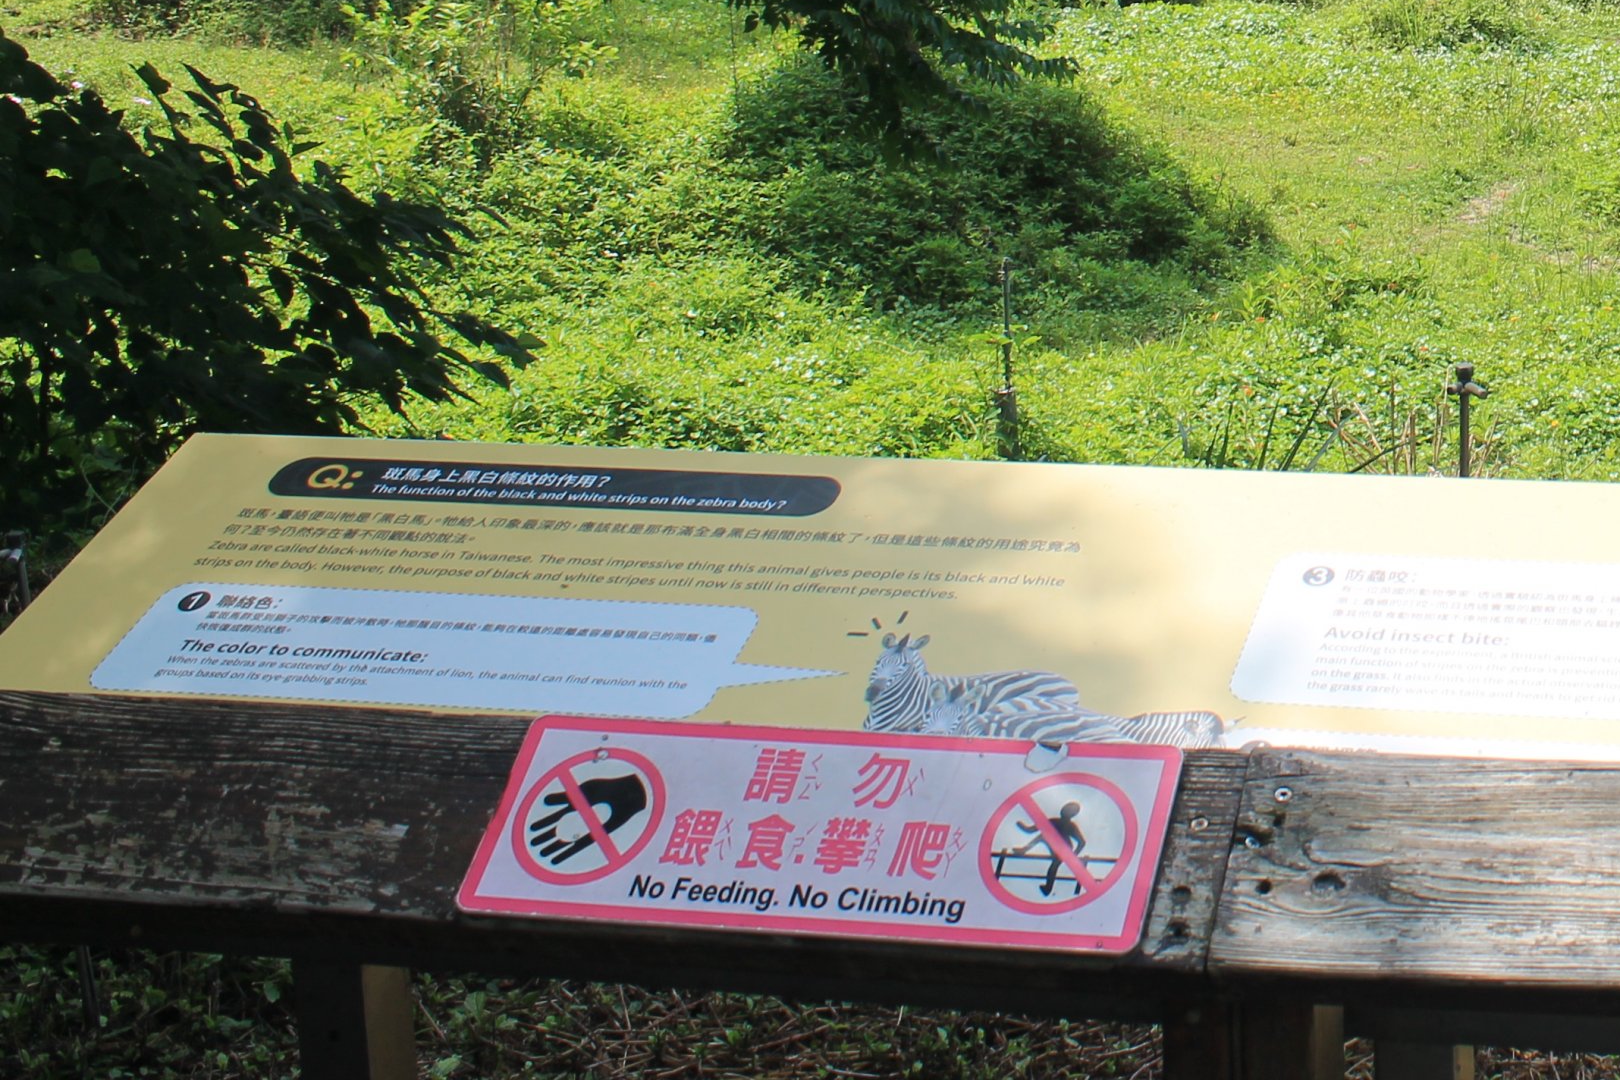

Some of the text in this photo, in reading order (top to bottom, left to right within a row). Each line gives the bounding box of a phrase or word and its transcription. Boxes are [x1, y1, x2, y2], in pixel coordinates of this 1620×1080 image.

[307, 464, 363, 490] Q:
[368, 482, 788, 512] The function of the black and white strips on the zebra body?
[207, 538, 247, 551] Zebra
[249, 542, 272, 552] are
[274, 541, 316, 554] called
[317, 542, 398, 557] black-white
[398, 545, 438, 559] horse
[441, 547, 454, 559] in
[456, 548, 536, 563] Taiwanese.
[536, 551, 565, 564] The
[567, 555, 606, 566] most
[605, 554, 683, 570] impressive
[686, 558, 726, 574] thing
[726, 560, 755, 572] this
[758, 562, 811, 575] animal
[810, 564, 850, 578] gives
[852, 567, 904, 582] people
[906, 568, 921, 580] is
[921, 569, 942, 581] its
[943, 570, 988, 584] black
[987, 573, 1020, 585] and
[194, 555, 957, 601] strips on the body. However, the purpose of black and white stripes until now is still in different perspectives.
[181, 638, 429, 662] The color to communicate:
[1324, 625, 1510, 646] Avoid insect bite:
[150, 667, 368, 688] groups based on its eye-grabbing strips.
[167, 653, 687, 689] When the zebras are scattered by the attachment of lion, the animal can find reunion with the
[628, 872, 965, 924] No Feeding. No Climbing
